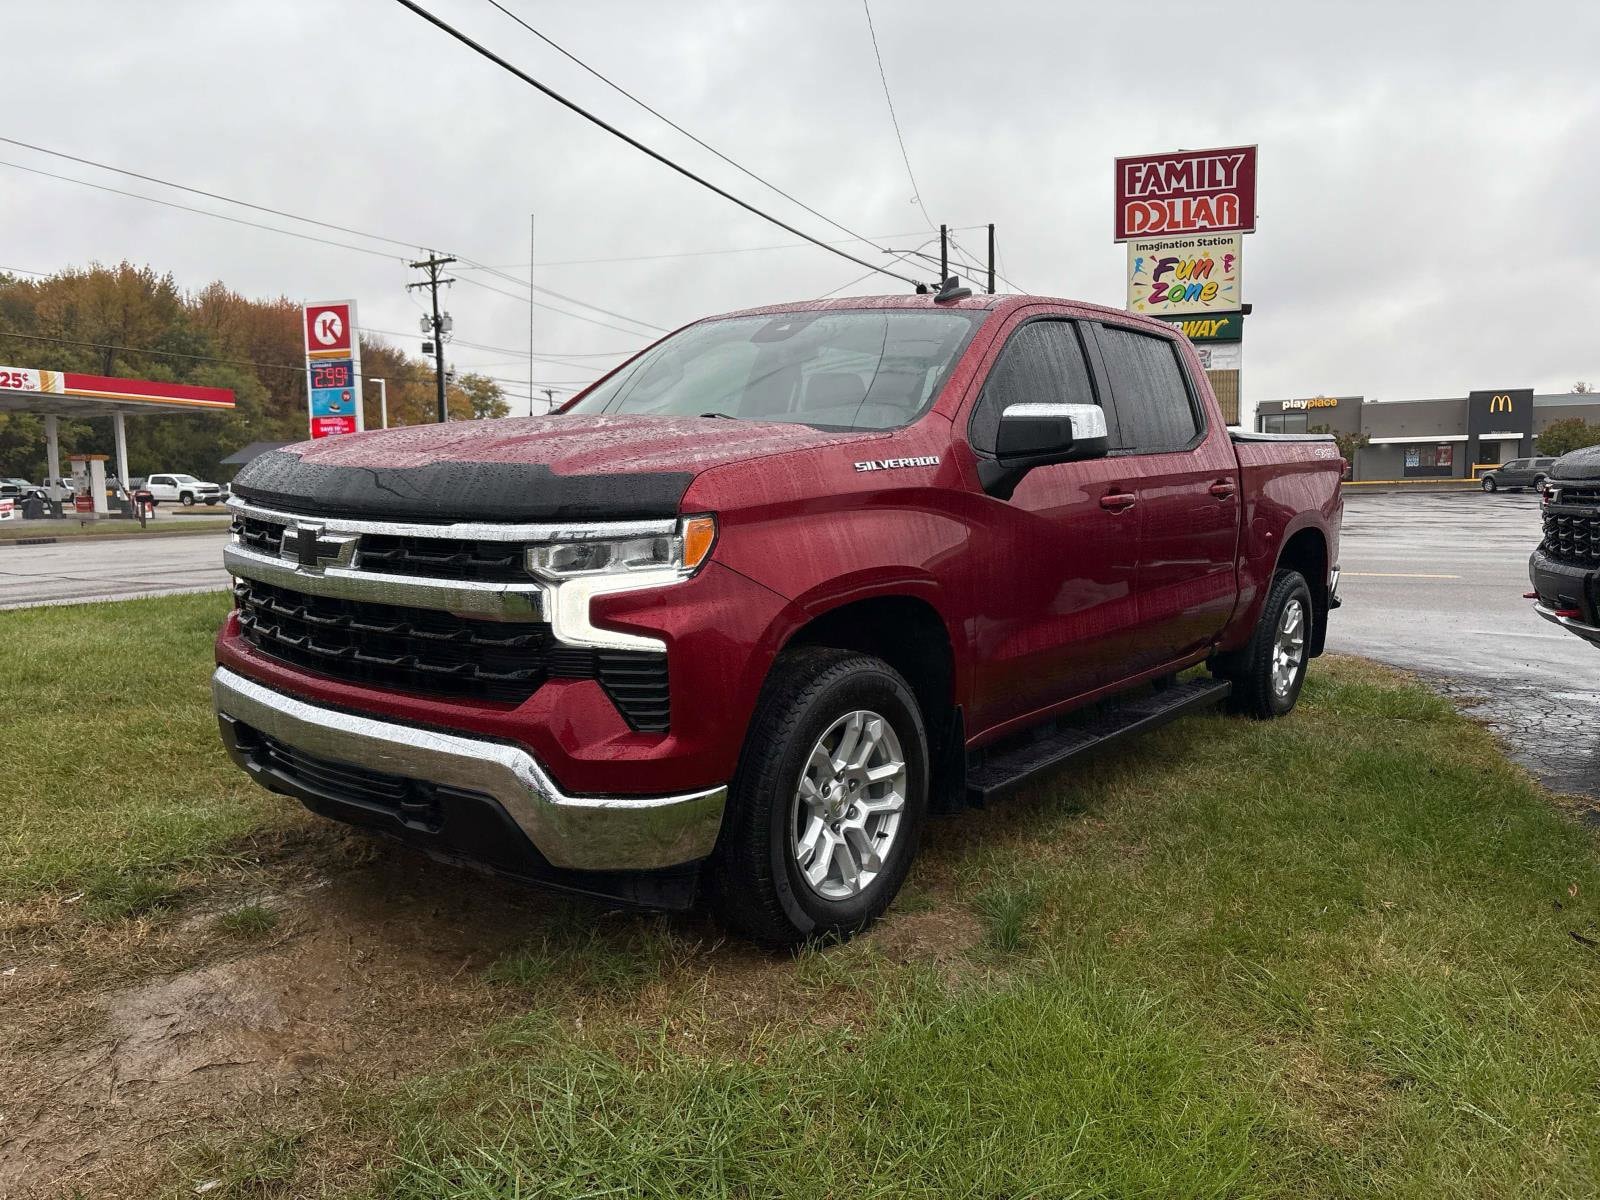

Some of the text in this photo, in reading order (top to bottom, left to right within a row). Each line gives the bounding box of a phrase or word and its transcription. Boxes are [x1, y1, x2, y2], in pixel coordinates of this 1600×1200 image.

[1125, 154, 1246, 197] FAMILY
[1125, 193, 1239, 235] DOLLAR
[1136, 236, 1234, 252] Imagination Station
[1152, 256, 1215, 283] Fun
[1282, 399, 1338, 410] playplace
[854, 455, 940, 472] SILVERADO
